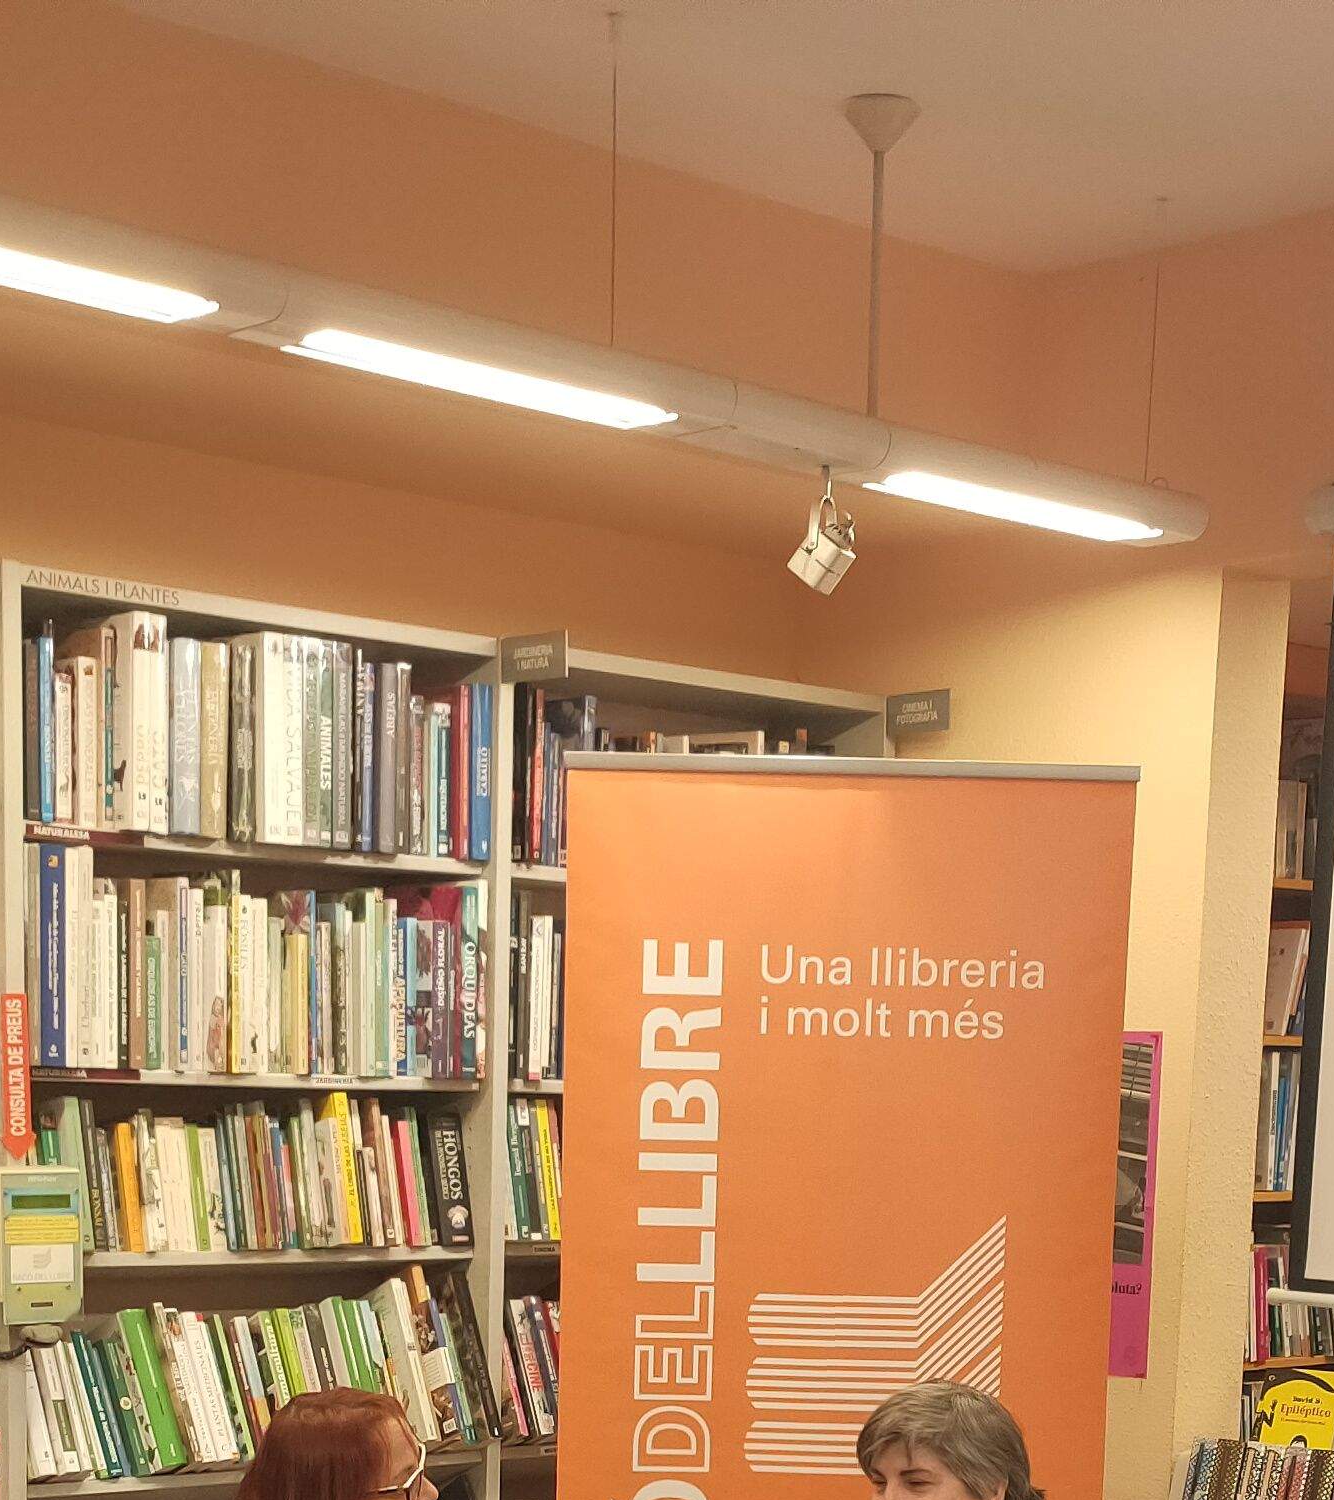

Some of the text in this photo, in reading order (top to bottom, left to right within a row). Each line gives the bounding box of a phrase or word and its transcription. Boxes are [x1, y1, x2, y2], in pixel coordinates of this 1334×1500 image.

[25, 569, 181, 606] ANIMALS I PLANTES
[522, 656, 550, 670] NATURA
[320, 715, 333, 791] ANIMALES
[759, 943, 1047, 990] Una llibreria
[760, 994, 1006, 1040] i molt més
[6, 998, 26, 1137] CONSULTA DE PREUS
[441, 1129, 464, 1201] HONGOS
[266, 1322, 291, 1401] ermacultura
[1280, 1403, 1332, 1419] Epiléptico
